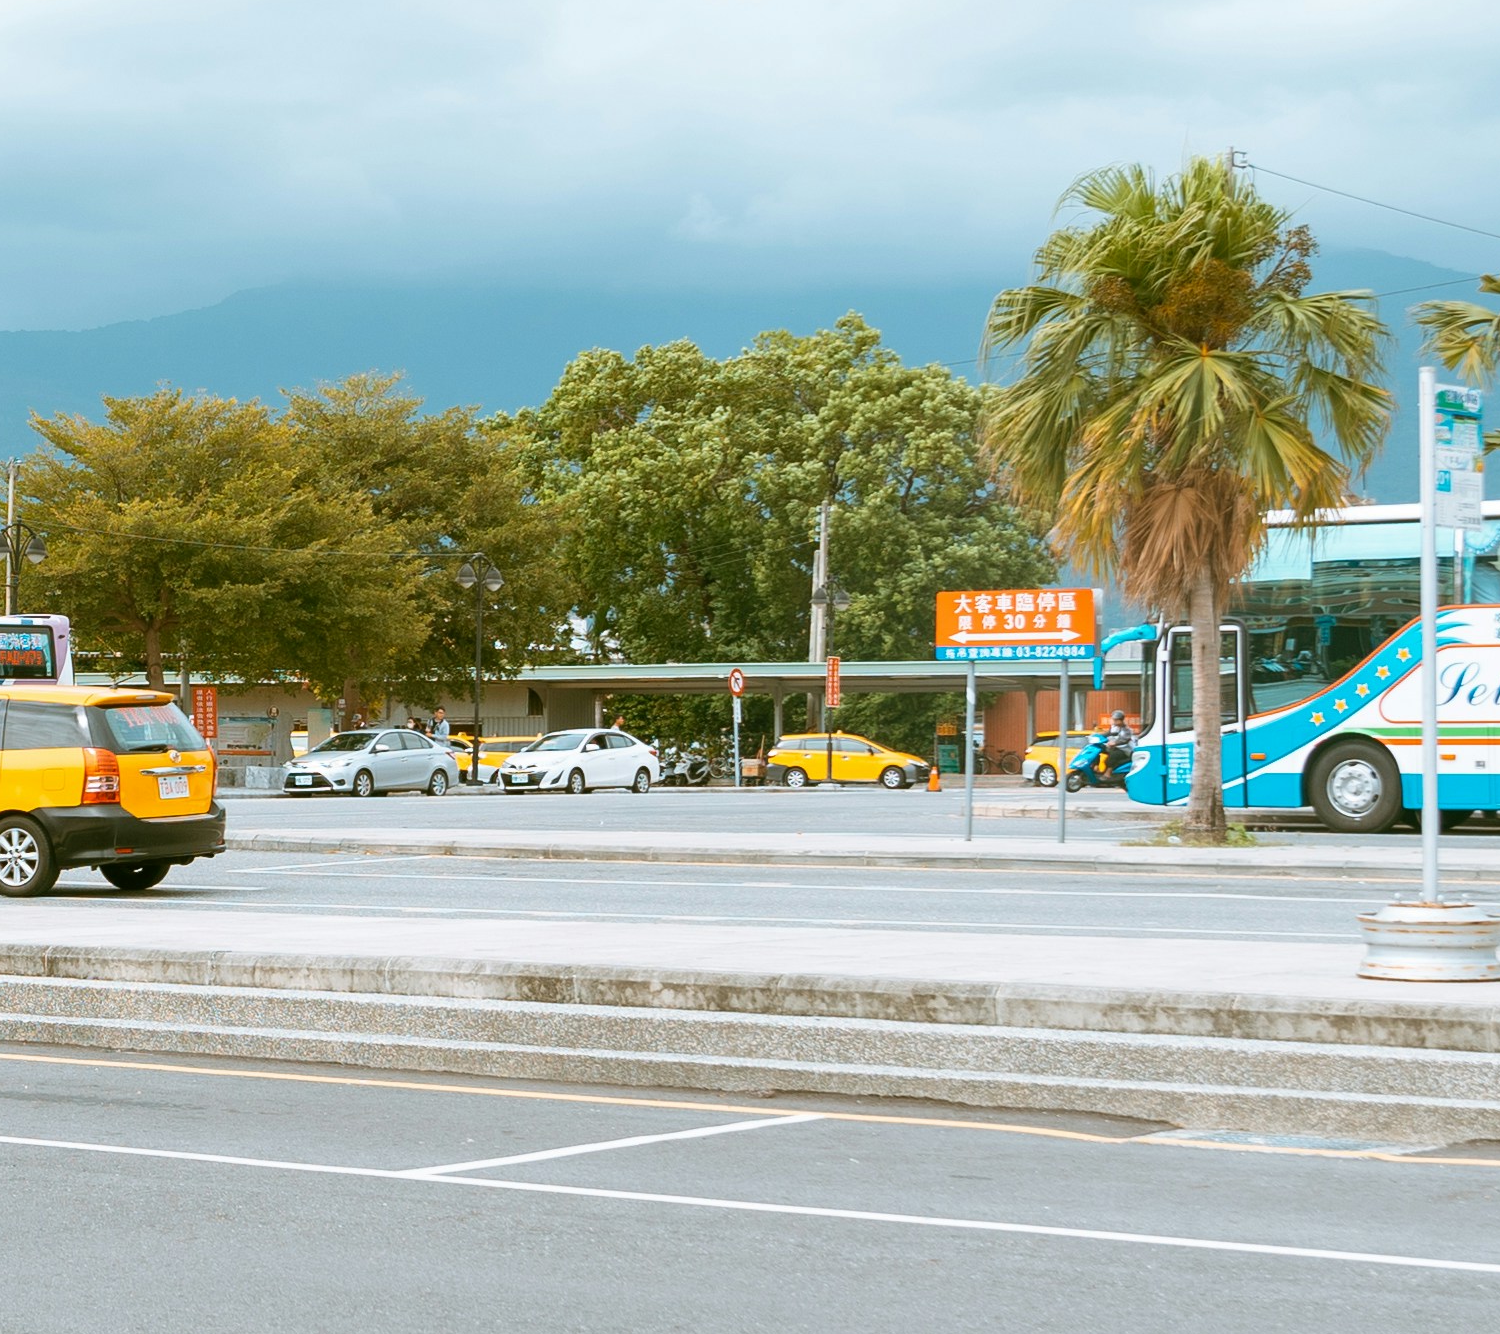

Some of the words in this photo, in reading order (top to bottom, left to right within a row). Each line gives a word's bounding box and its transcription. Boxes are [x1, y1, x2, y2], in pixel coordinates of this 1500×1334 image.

[953, 592, 1077, 614] 大客車臨停區
